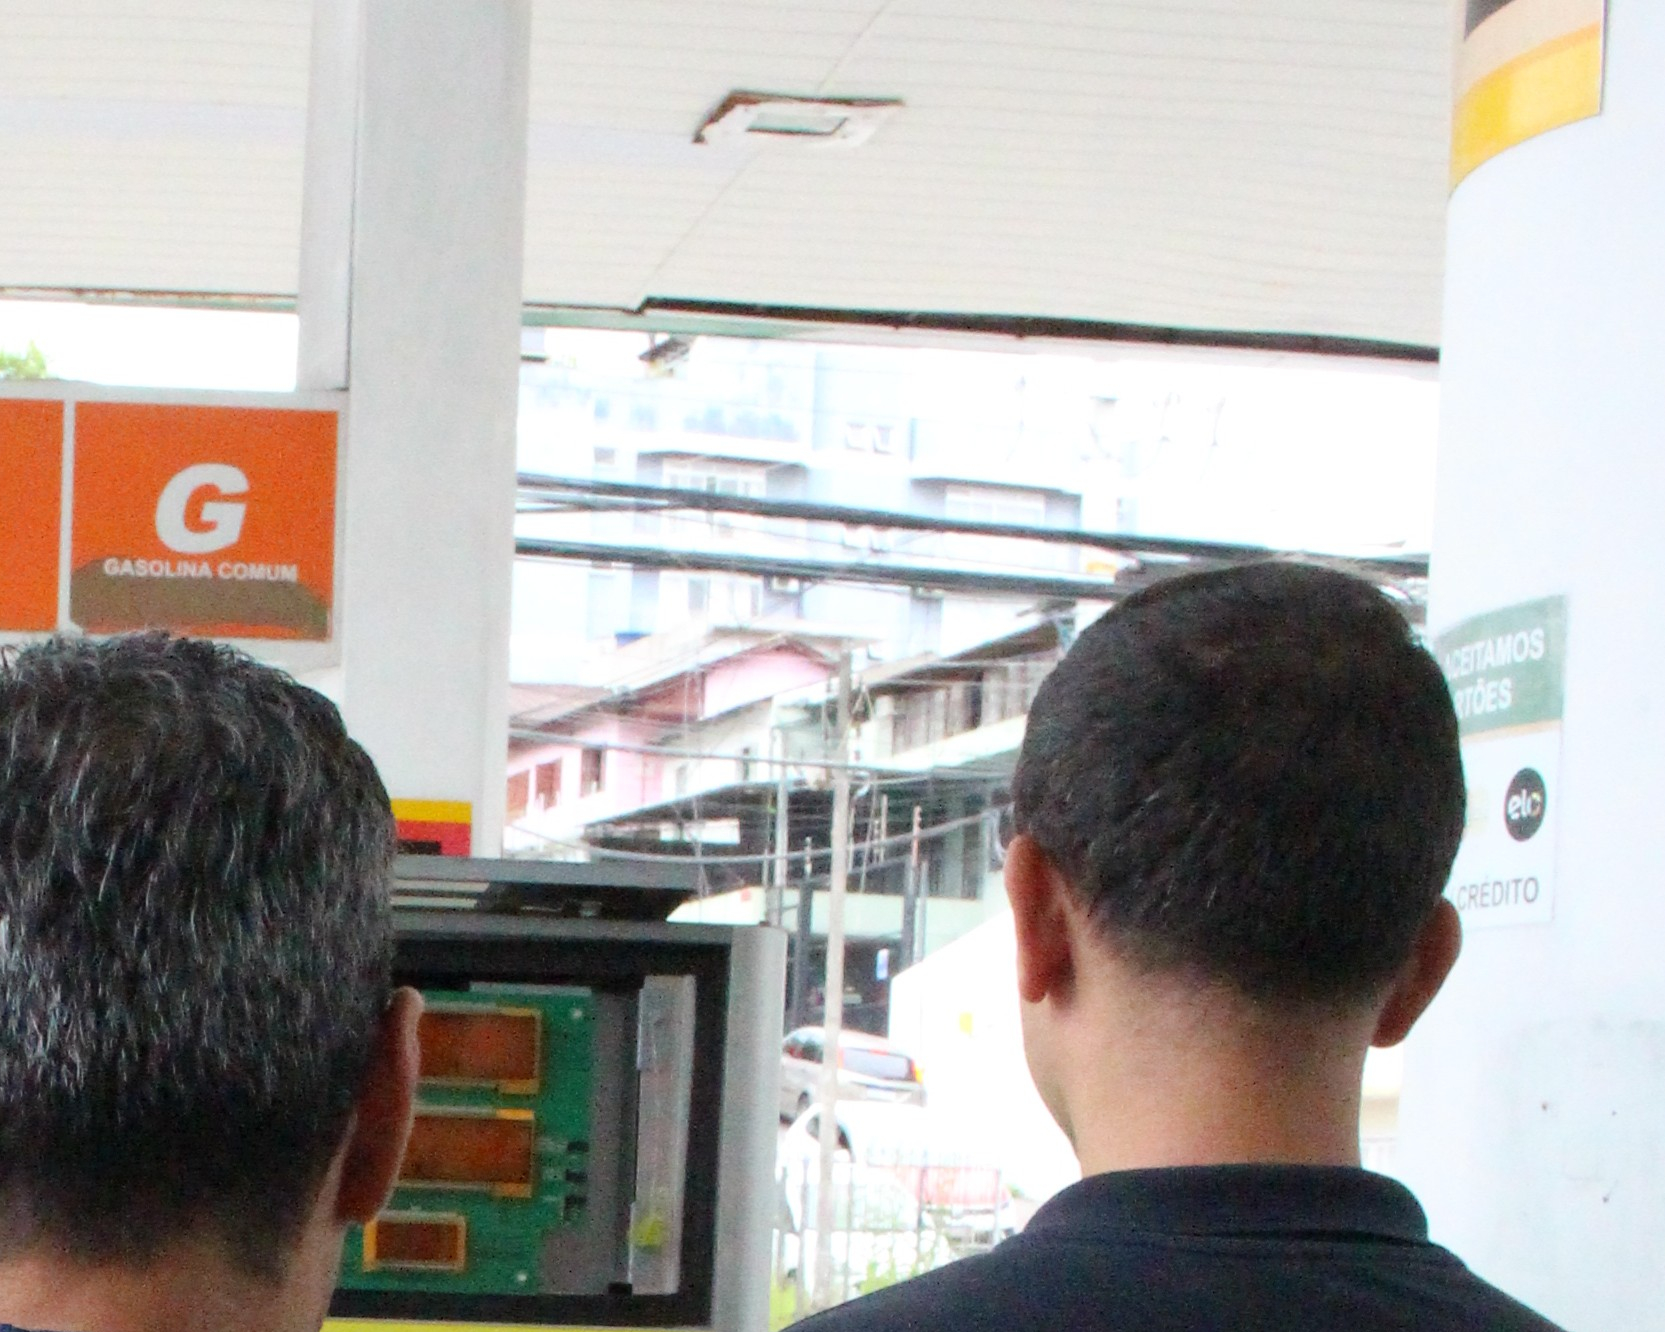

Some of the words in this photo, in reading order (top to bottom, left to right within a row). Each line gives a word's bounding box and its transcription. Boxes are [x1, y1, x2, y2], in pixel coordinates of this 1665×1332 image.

[154, 462, 251, 555] G
[103, 556, 212, 579] GASOLINA
[217, 560, 298, 583] COMUM
[1453, 677, 1513, 720] RTÕES
[1457, 874, 1540, 912] CRÉDITO
